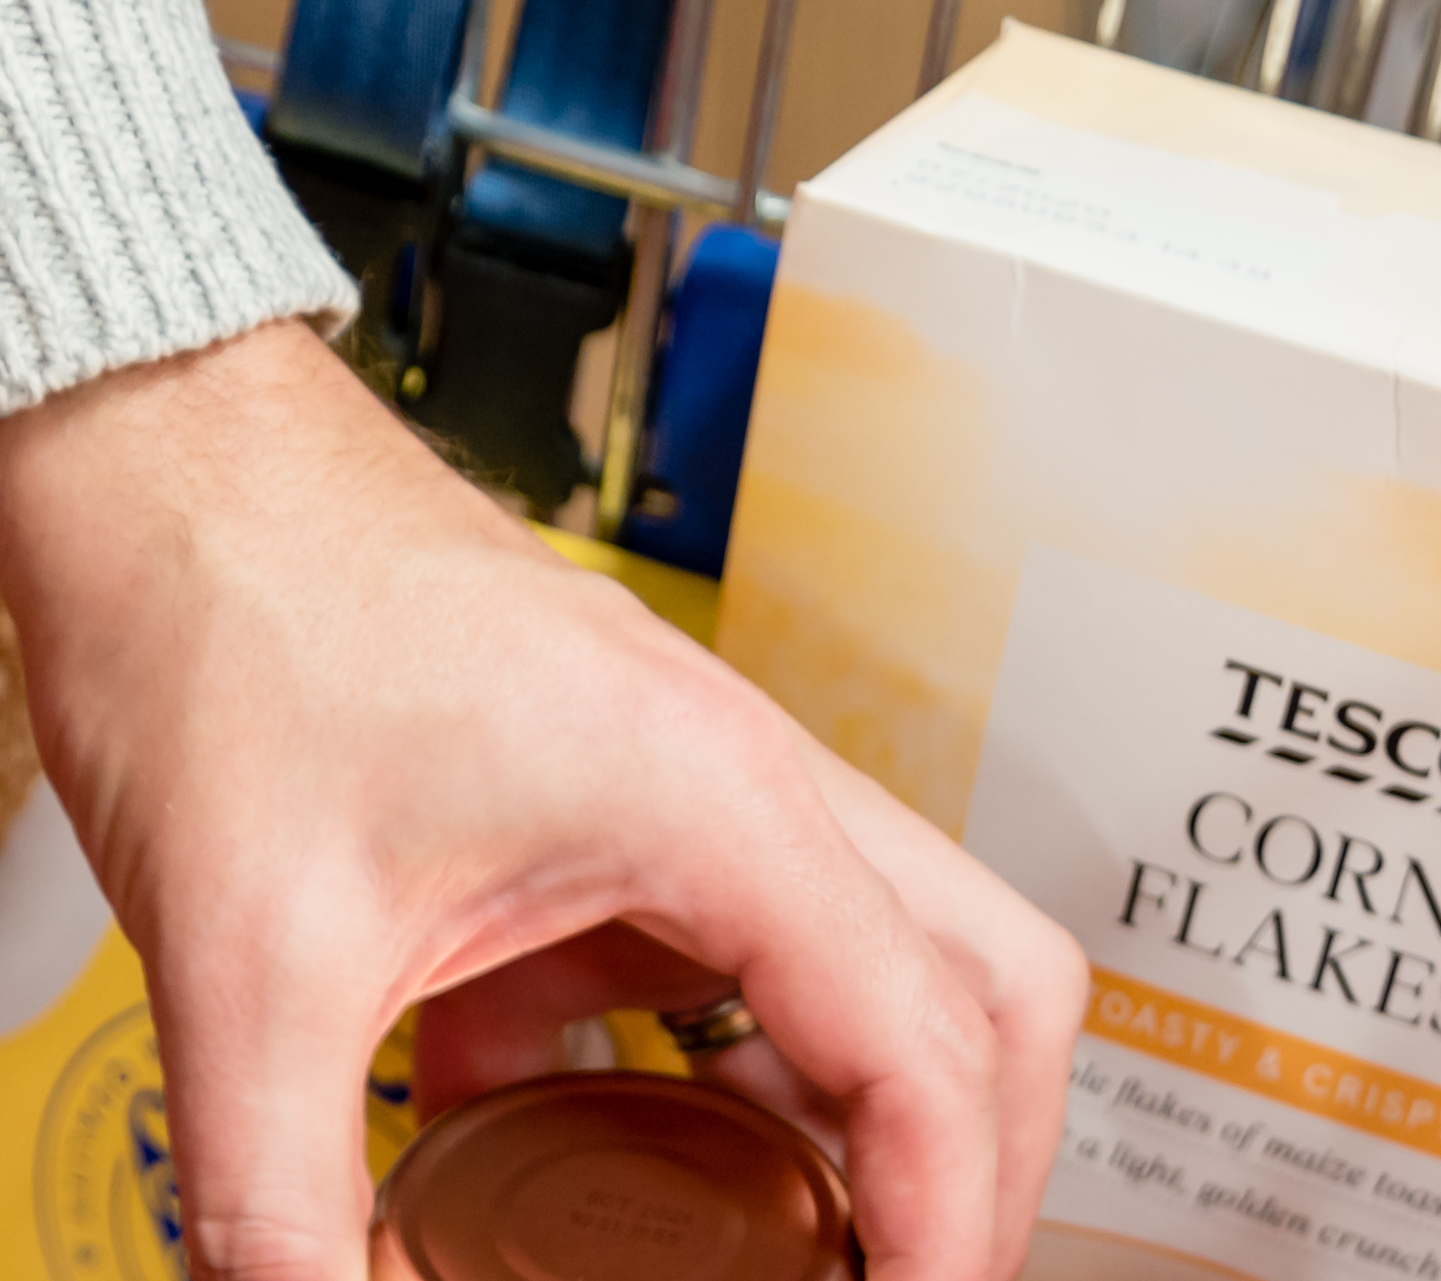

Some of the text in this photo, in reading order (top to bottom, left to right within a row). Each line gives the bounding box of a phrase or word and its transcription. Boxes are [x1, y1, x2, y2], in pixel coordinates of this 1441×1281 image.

[1255, 1048, 1280, 1081] &
[1115, 1072, 1211, 1133] flakes
[1221, 1122, 1264, 1152] of
[1264, 1139, 1366, 1188] maize
